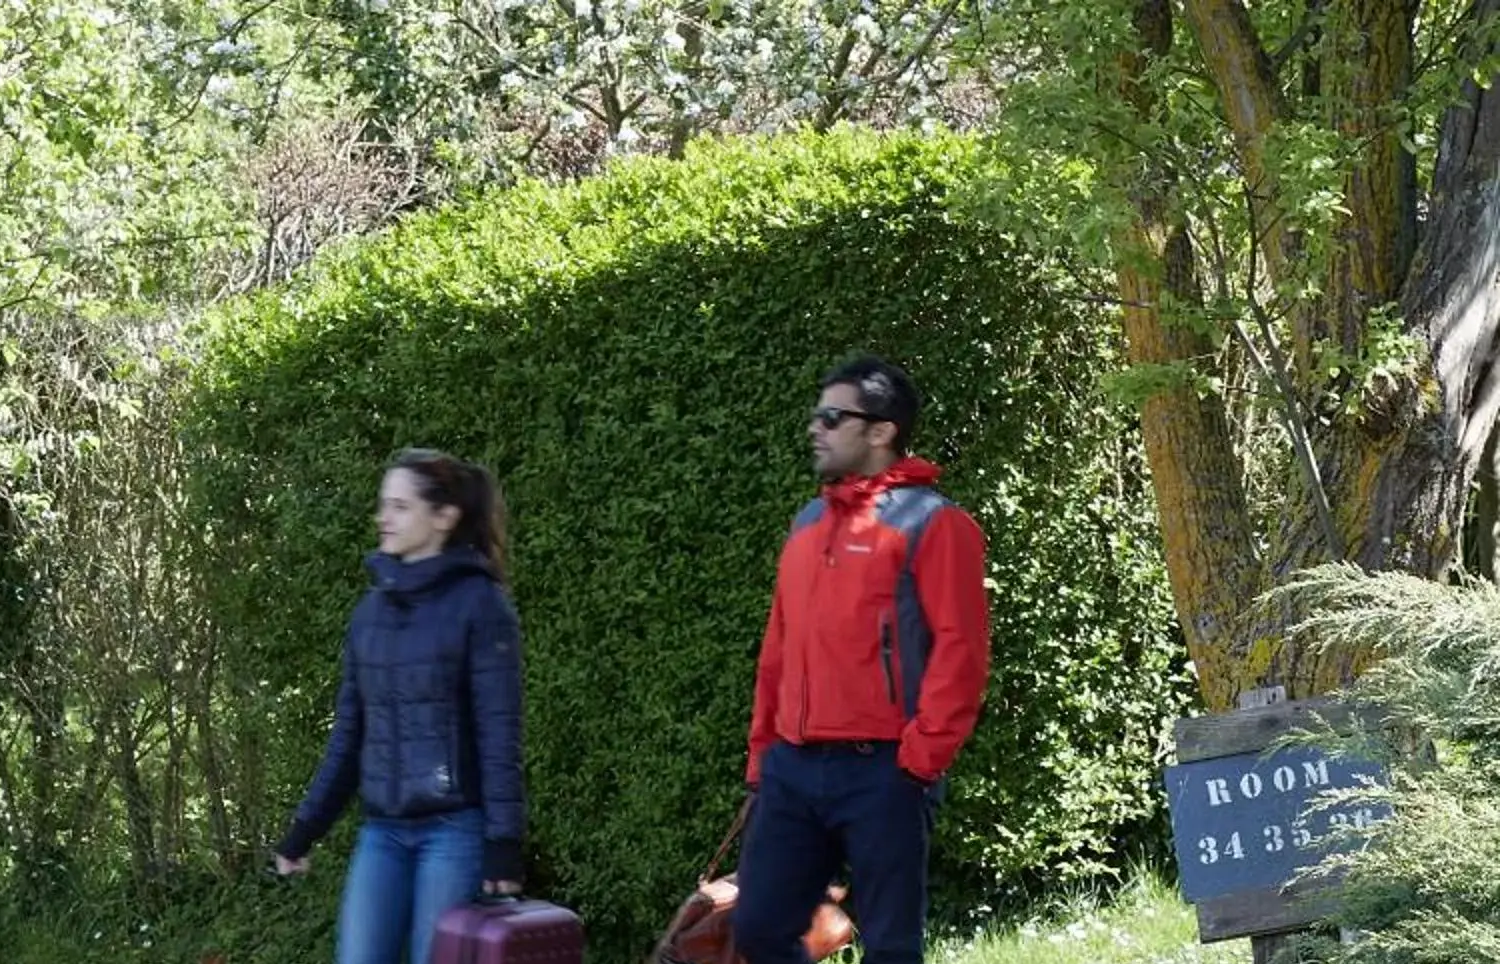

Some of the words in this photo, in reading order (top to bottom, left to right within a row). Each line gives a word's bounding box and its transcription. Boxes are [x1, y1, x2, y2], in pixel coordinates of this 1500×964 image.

[1205, 760, 1330, 806] ROOM
[1198, 831, 1245, 865] 34
[1263, 819, 1311, 852] 35
